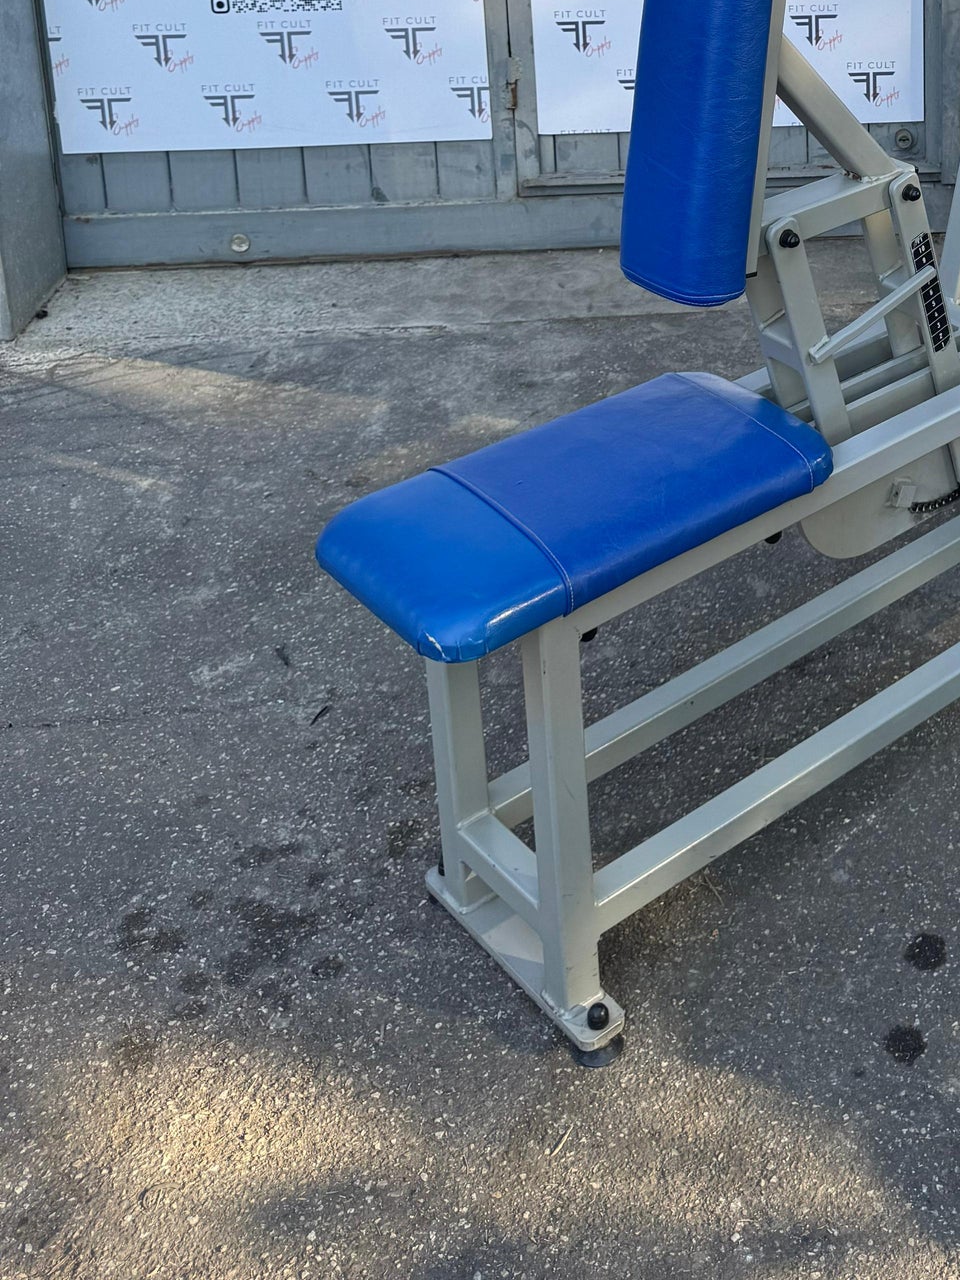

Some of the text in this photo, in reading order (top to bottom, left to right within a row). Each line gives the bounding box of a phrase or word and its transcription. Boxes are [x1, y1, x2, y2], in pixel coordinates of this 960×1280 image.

[132, 23, 186, 32] FIT CULT
[201, 83, 254, 93] FIT CULT
